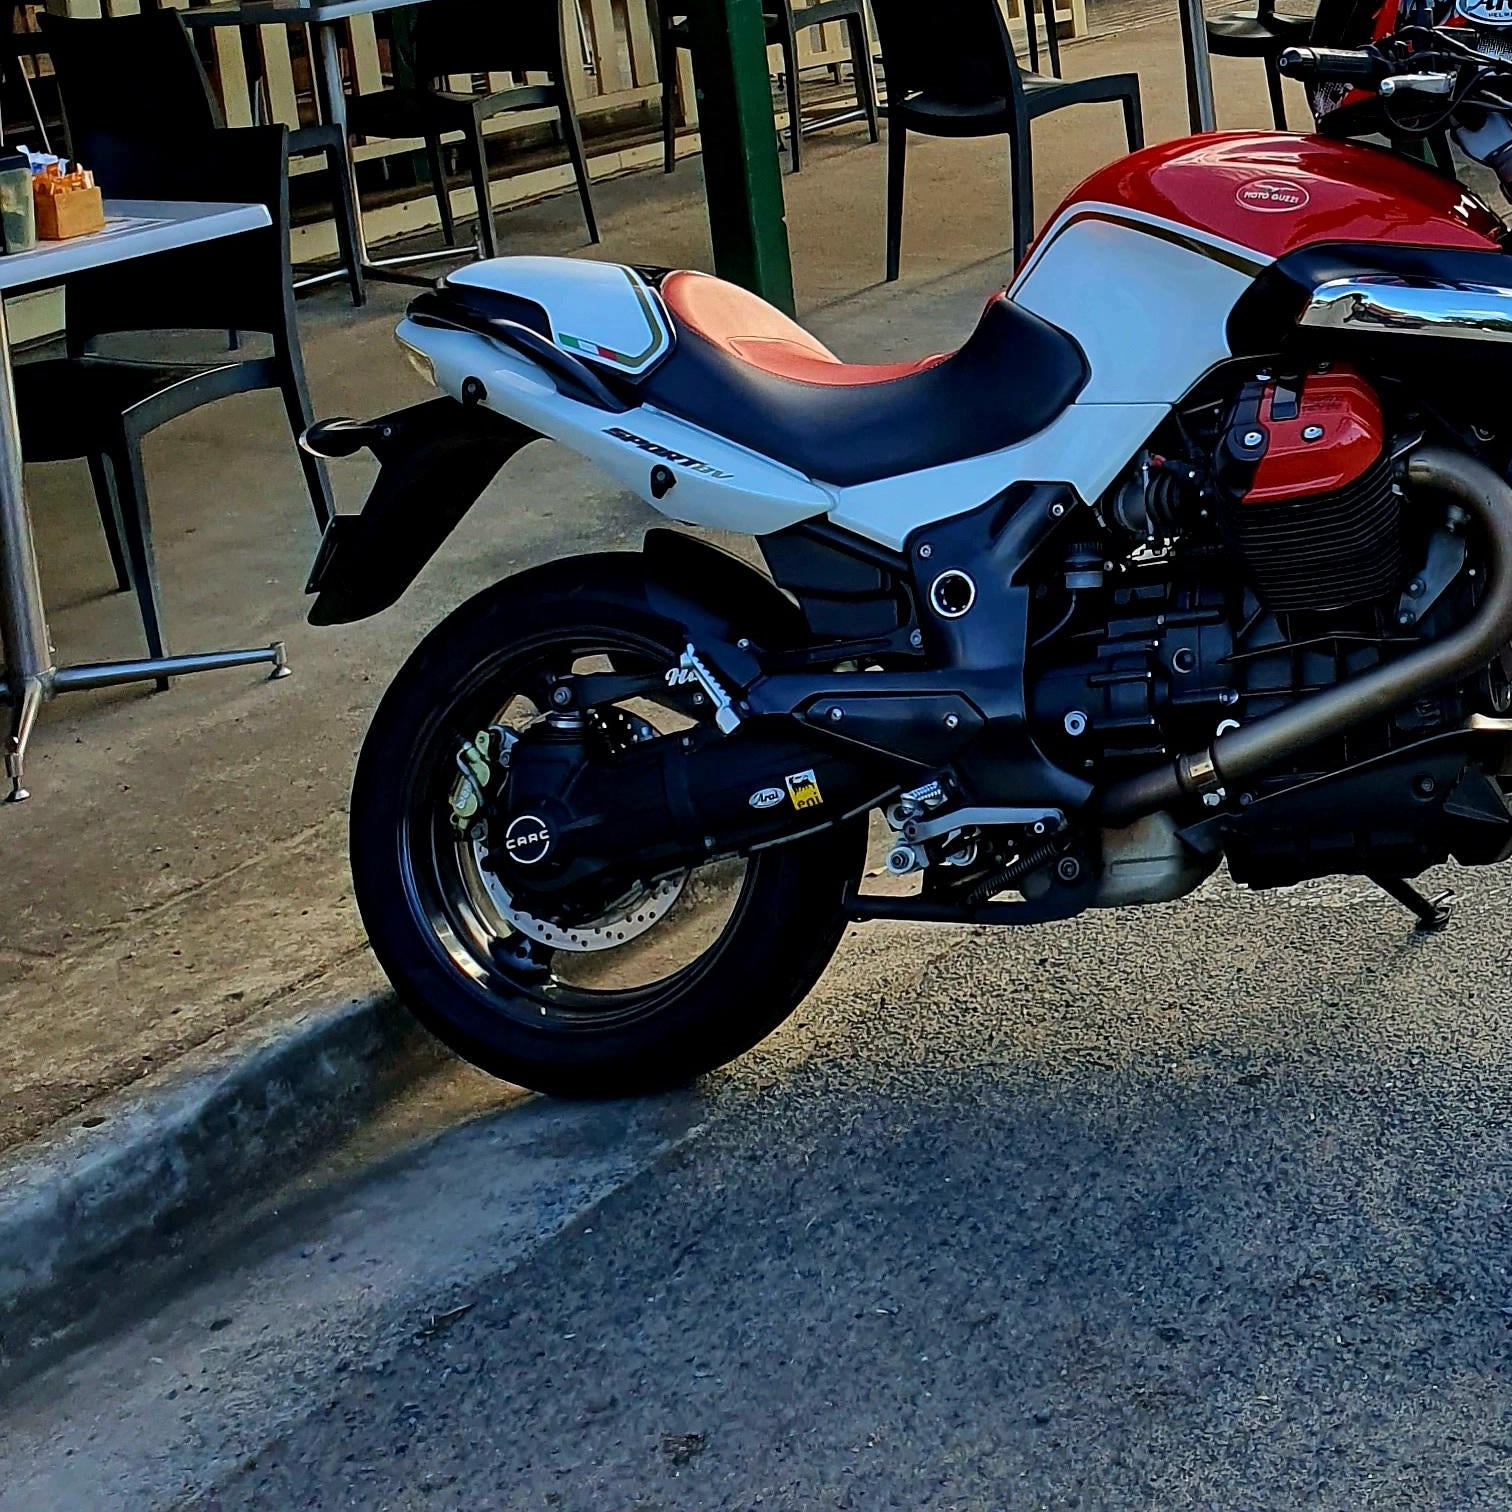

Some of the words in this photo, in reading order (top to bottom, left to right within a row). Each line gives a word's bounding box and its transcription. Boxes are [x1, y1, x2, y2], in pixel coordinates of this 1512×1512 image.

[1244, 191, 1270, 199] MOTO
[1271, 193, 1299, 204] GUZZI
[754, 789, 779, 805] Arai
[797, 792, 820, 807] eni
[505, 829, 550, 850] CARC
